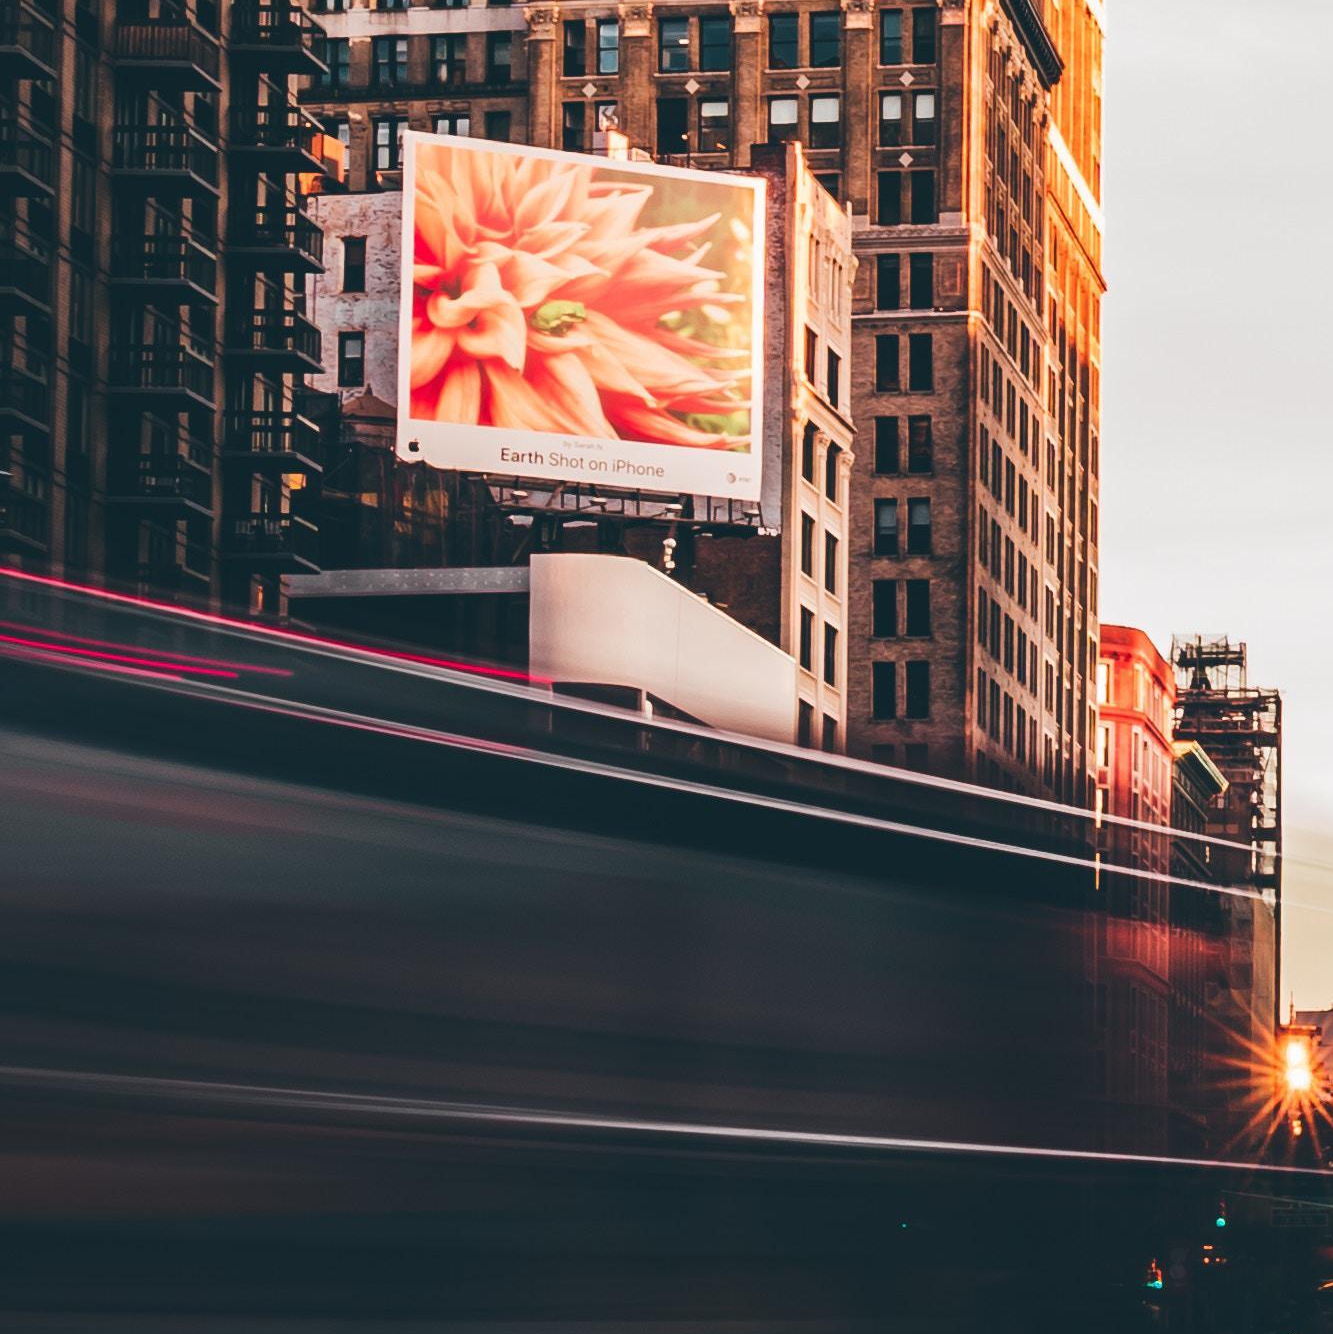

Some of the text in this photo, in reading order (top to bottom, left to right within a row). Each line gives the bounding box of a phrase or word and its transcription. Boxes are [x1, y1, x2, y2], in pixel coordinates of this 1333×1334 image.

[500, 447, 665, 477] Earth Shot on iPhone
